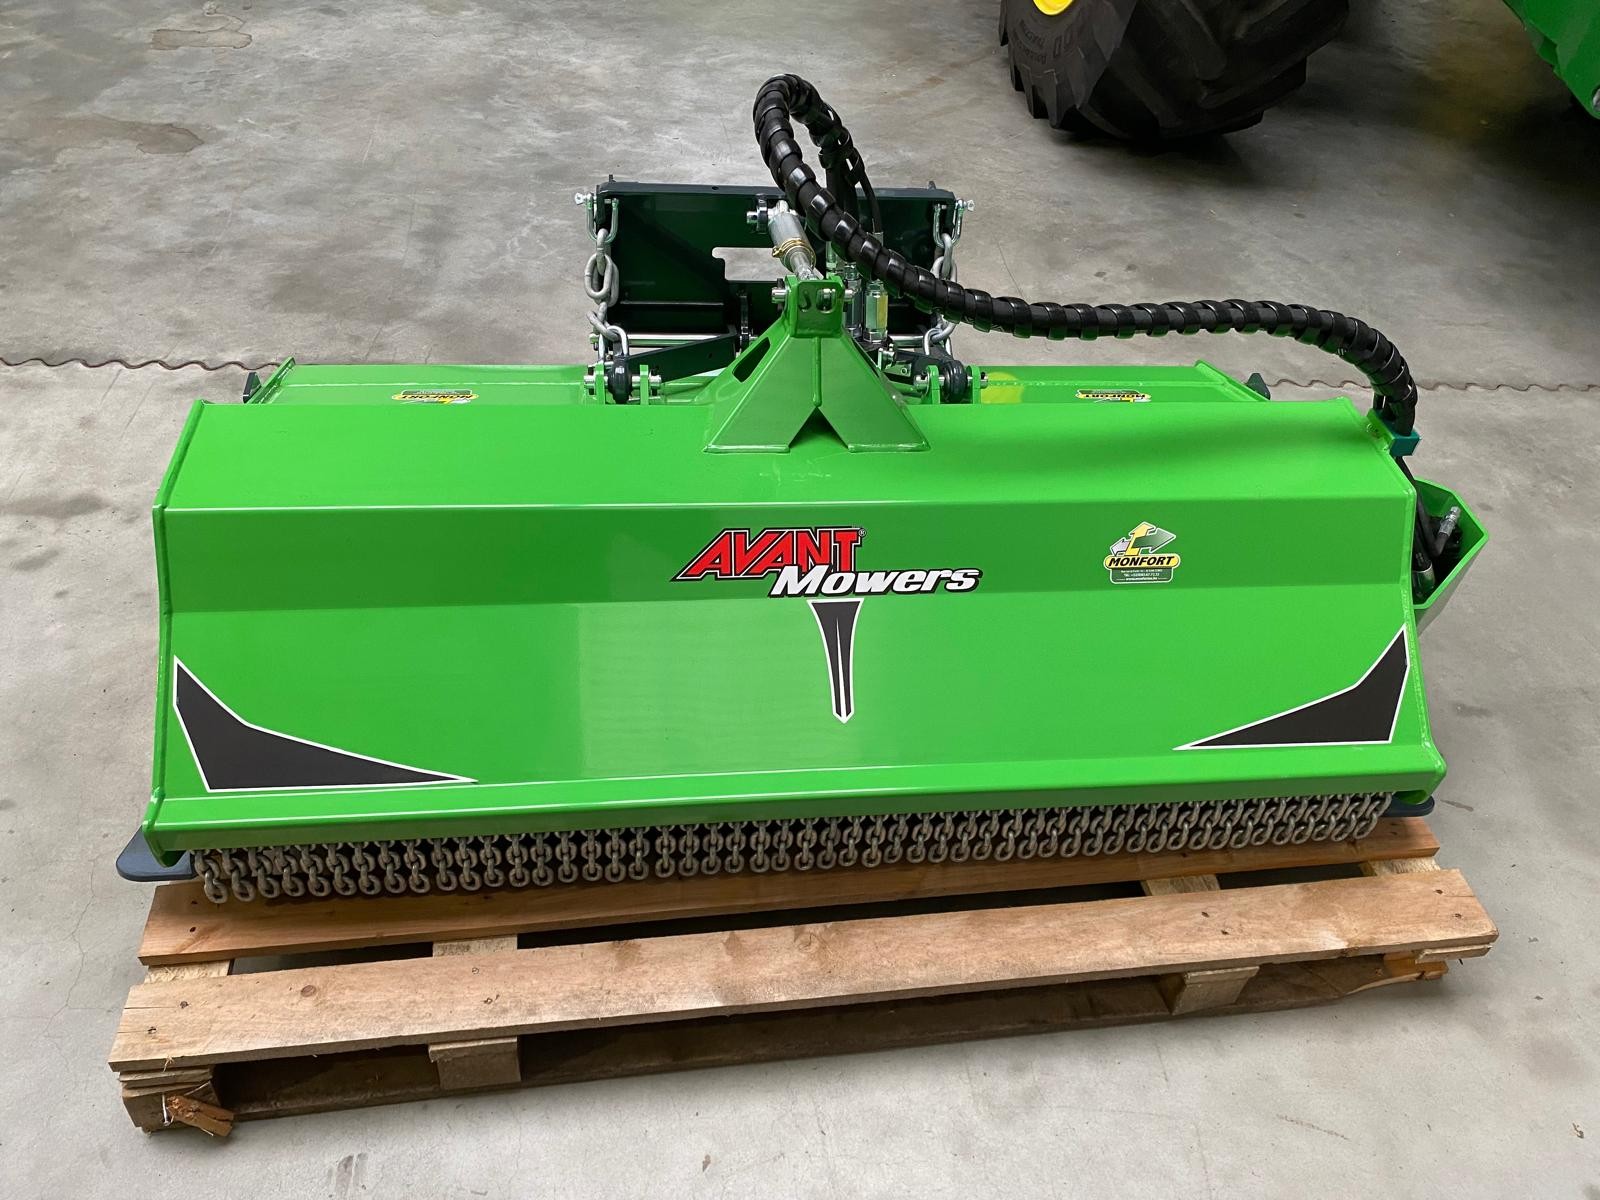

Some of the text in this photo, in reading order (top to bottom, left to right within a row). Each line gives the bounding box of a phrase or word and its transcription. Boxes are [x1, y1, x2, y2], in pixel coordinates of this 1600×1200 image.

[673, 528, 860, 580] AVANT
[1108, 556, 1175, 567] MONFORT
[769, 564, 980, 596] Mowers
